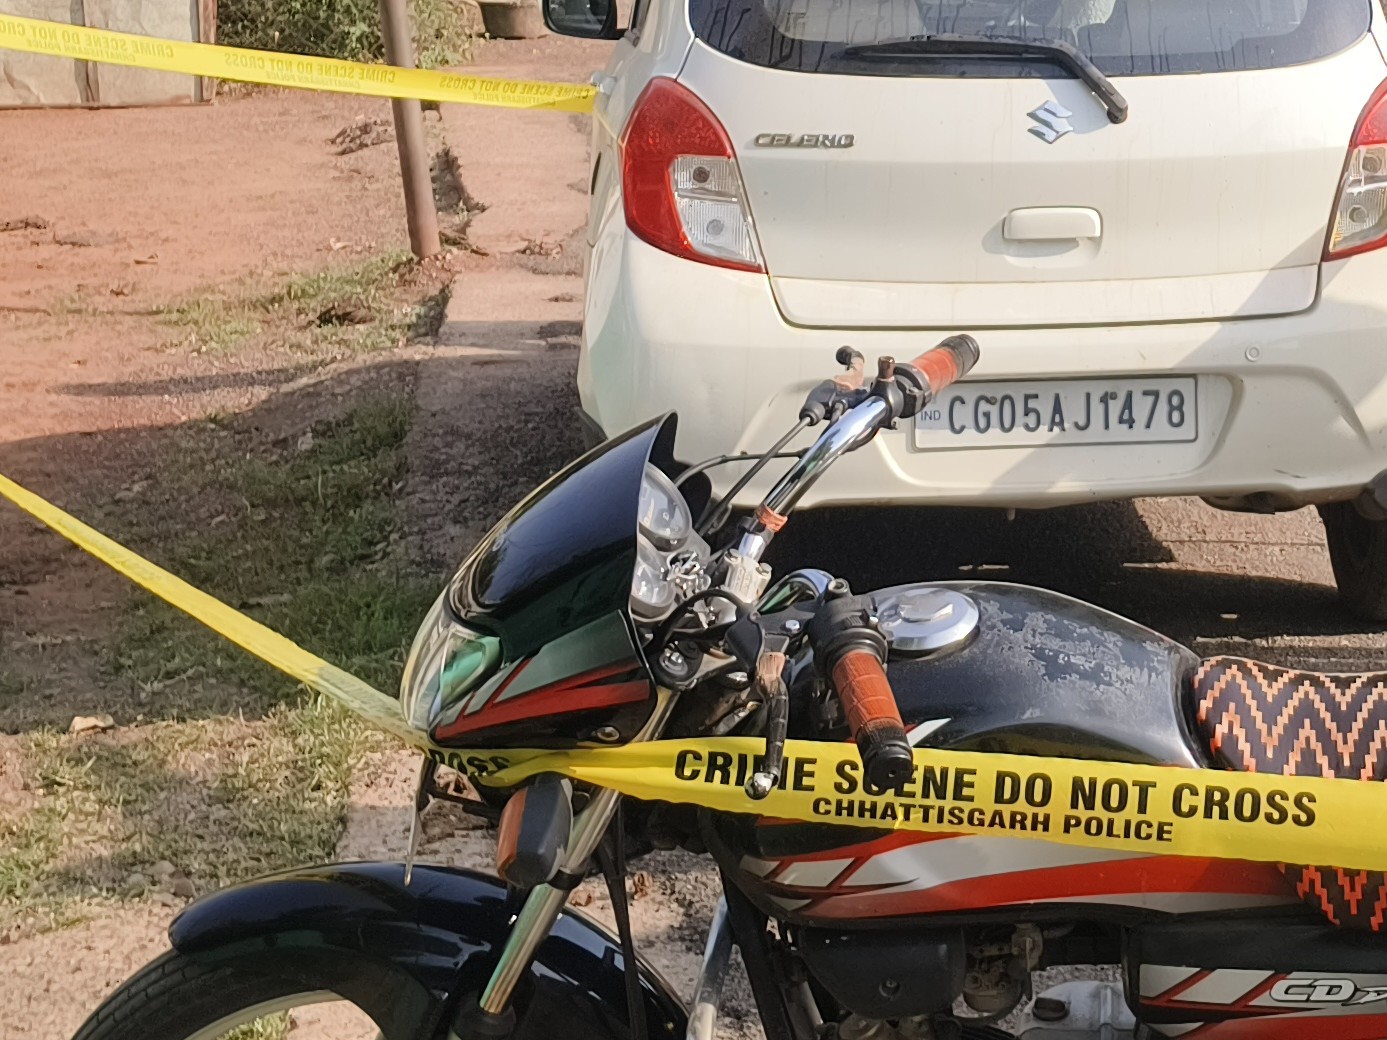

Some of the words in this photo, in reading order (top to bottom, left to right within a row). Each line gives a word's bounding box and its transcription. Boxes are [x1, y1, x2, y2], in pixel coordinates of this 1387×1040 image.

[753, 133, 855, 148] CELERIO
[920, 410, 941, 421] IND
[949, 389, 1186, 435] CG05AJ1478
[994, 769, 1052, 808] DO
[1070, 775, 1157, 815] NOT
[1172, 782, 1317, 827] CROSS
[812, 797, 1051, 833] CHHATTISGARH
[1063, 815, 1174, 842] POLICE
[1269, 978, 1357, 1003] CD
